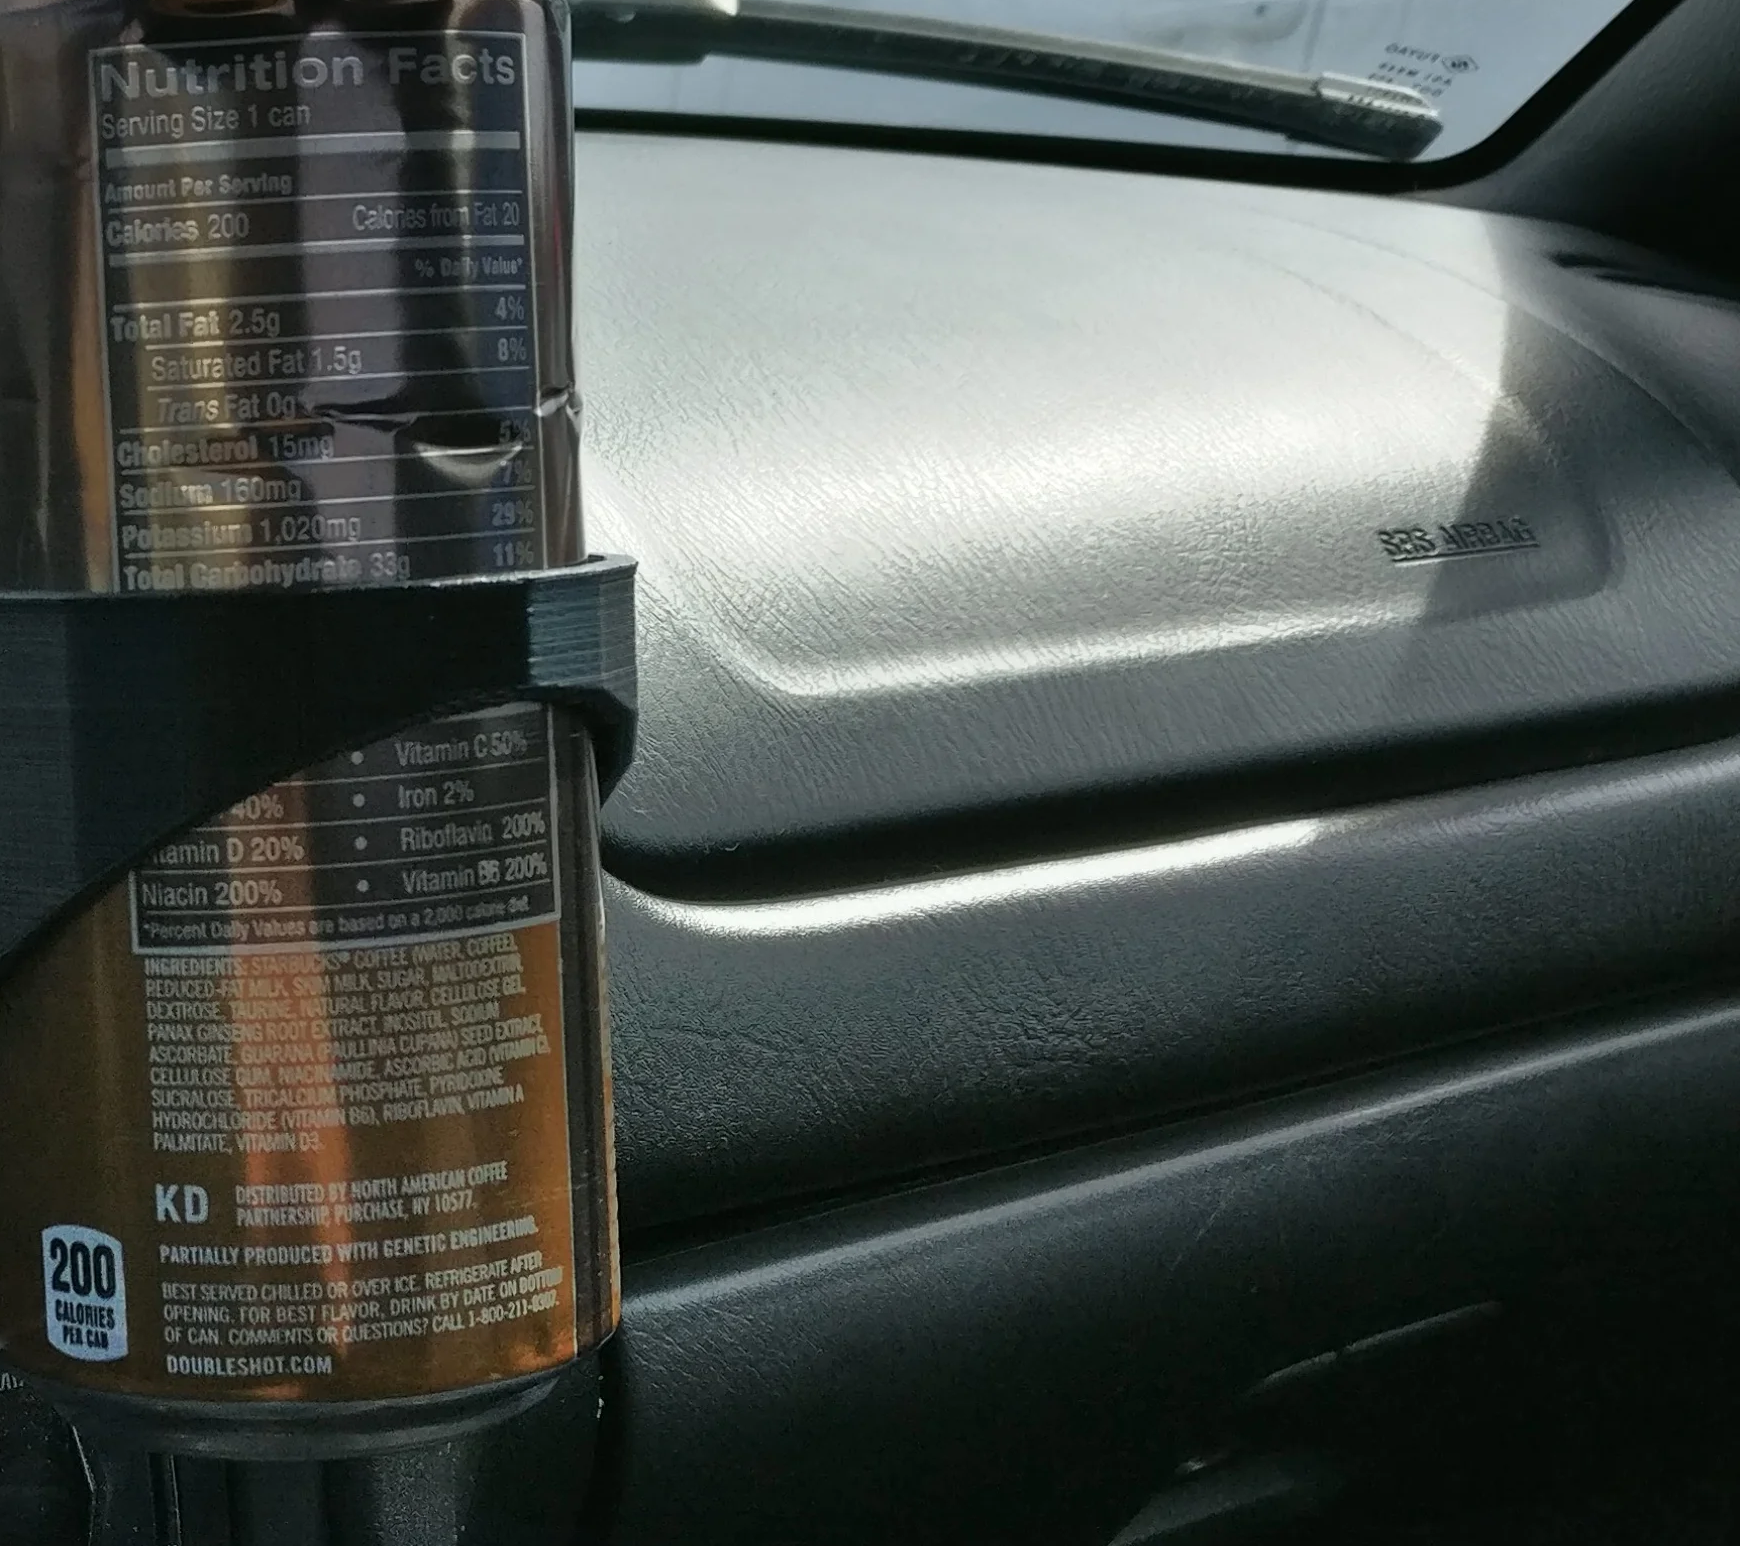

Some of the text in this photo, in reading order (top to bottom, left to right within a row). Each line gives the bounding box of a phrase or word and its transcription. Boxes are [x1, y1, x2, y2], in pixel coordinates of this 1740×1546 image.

[100, 47, 516, 102] Nutrition Facts
[103, 103, 311, 139] Serving Size 1 can
[104, 173, 293, 203] Amount Per Serving
[106, 213, 250, 248] Calories 200
[352, 201, 520, 232] Calories from Fat 20
[109, 297, 524, 343] Total Fat 2.5g 4%
[151, 337, 526, 382] Saturated Fat 1.5g 8%
[158, 393, 299, 424] Trans Fat 0g
[118, 436, 258, 465] Cholesterol
[270, 434, 335, 462] 15mg
[120, 480, 213, 508] Sodium
[221, 476, 302, 504] 160mg
[122, 503, 534, 551] Potassium 1,020mg 29%
[1377, 515, 1538, 558] SRS AIRBAG
[124, 542, 534, 592] Total Carbohydrate 33g 11%
[394, 731, 529, 767] Vitamin C 50%
[398, 780, 475, 810] Iron 2%
[226, 838, 244, 863] D
[251, 835, 306, 863] 20%
[400, 811, 546, 852] Riboflavin 200%
[402, 853, 548, 896] Vitamin B6 200%
[142, 879, 284, 909] Niacin 200%
[235, 1160, 508, 1206] DISTRIBUTED BY NORTH AMERICAN COFFEE
[154, 1182, 210, 1224] KD
[412, 1196, 431, 1216] NY
[158, 1243, 240, 1267] PARTIALLY
[243, 1244, 333, 1266] PRODUCED
[336, 1240, 379, 1263] WITH
[382, 1232, 447, 1260] GENETIC
[50, 1237, 117, 1299] 200
[161, 1249, 543, 1302] BEST SERVED CHILLED OR OVER REFRIGERATE AFTER
[55, 1299, 116, 1331] CALORIES
[239, 1304, 271, 1325] FOR
[275, 1304, 317, 1324] BEST
[389, 1294, 437, 1317] DRINK
[440, 1290, 460, 1311] BY
[463, 1283, 496, 1307] DATE
[499, 1279, 518, 1299] ON
[63, 1325, 110, 1349] PER CAN
[163, 1325, 183, 1345] OF
[227, 1326, 314, 1347] COMMENTS
[316, 1325, 338, 1344] OR
[341, 1317, 430, 1344] QUESTIONS?
[432, 1308, 466, 1334] CALL
[166, 1354, 333, 1376] DOUBLESHOT.COM
